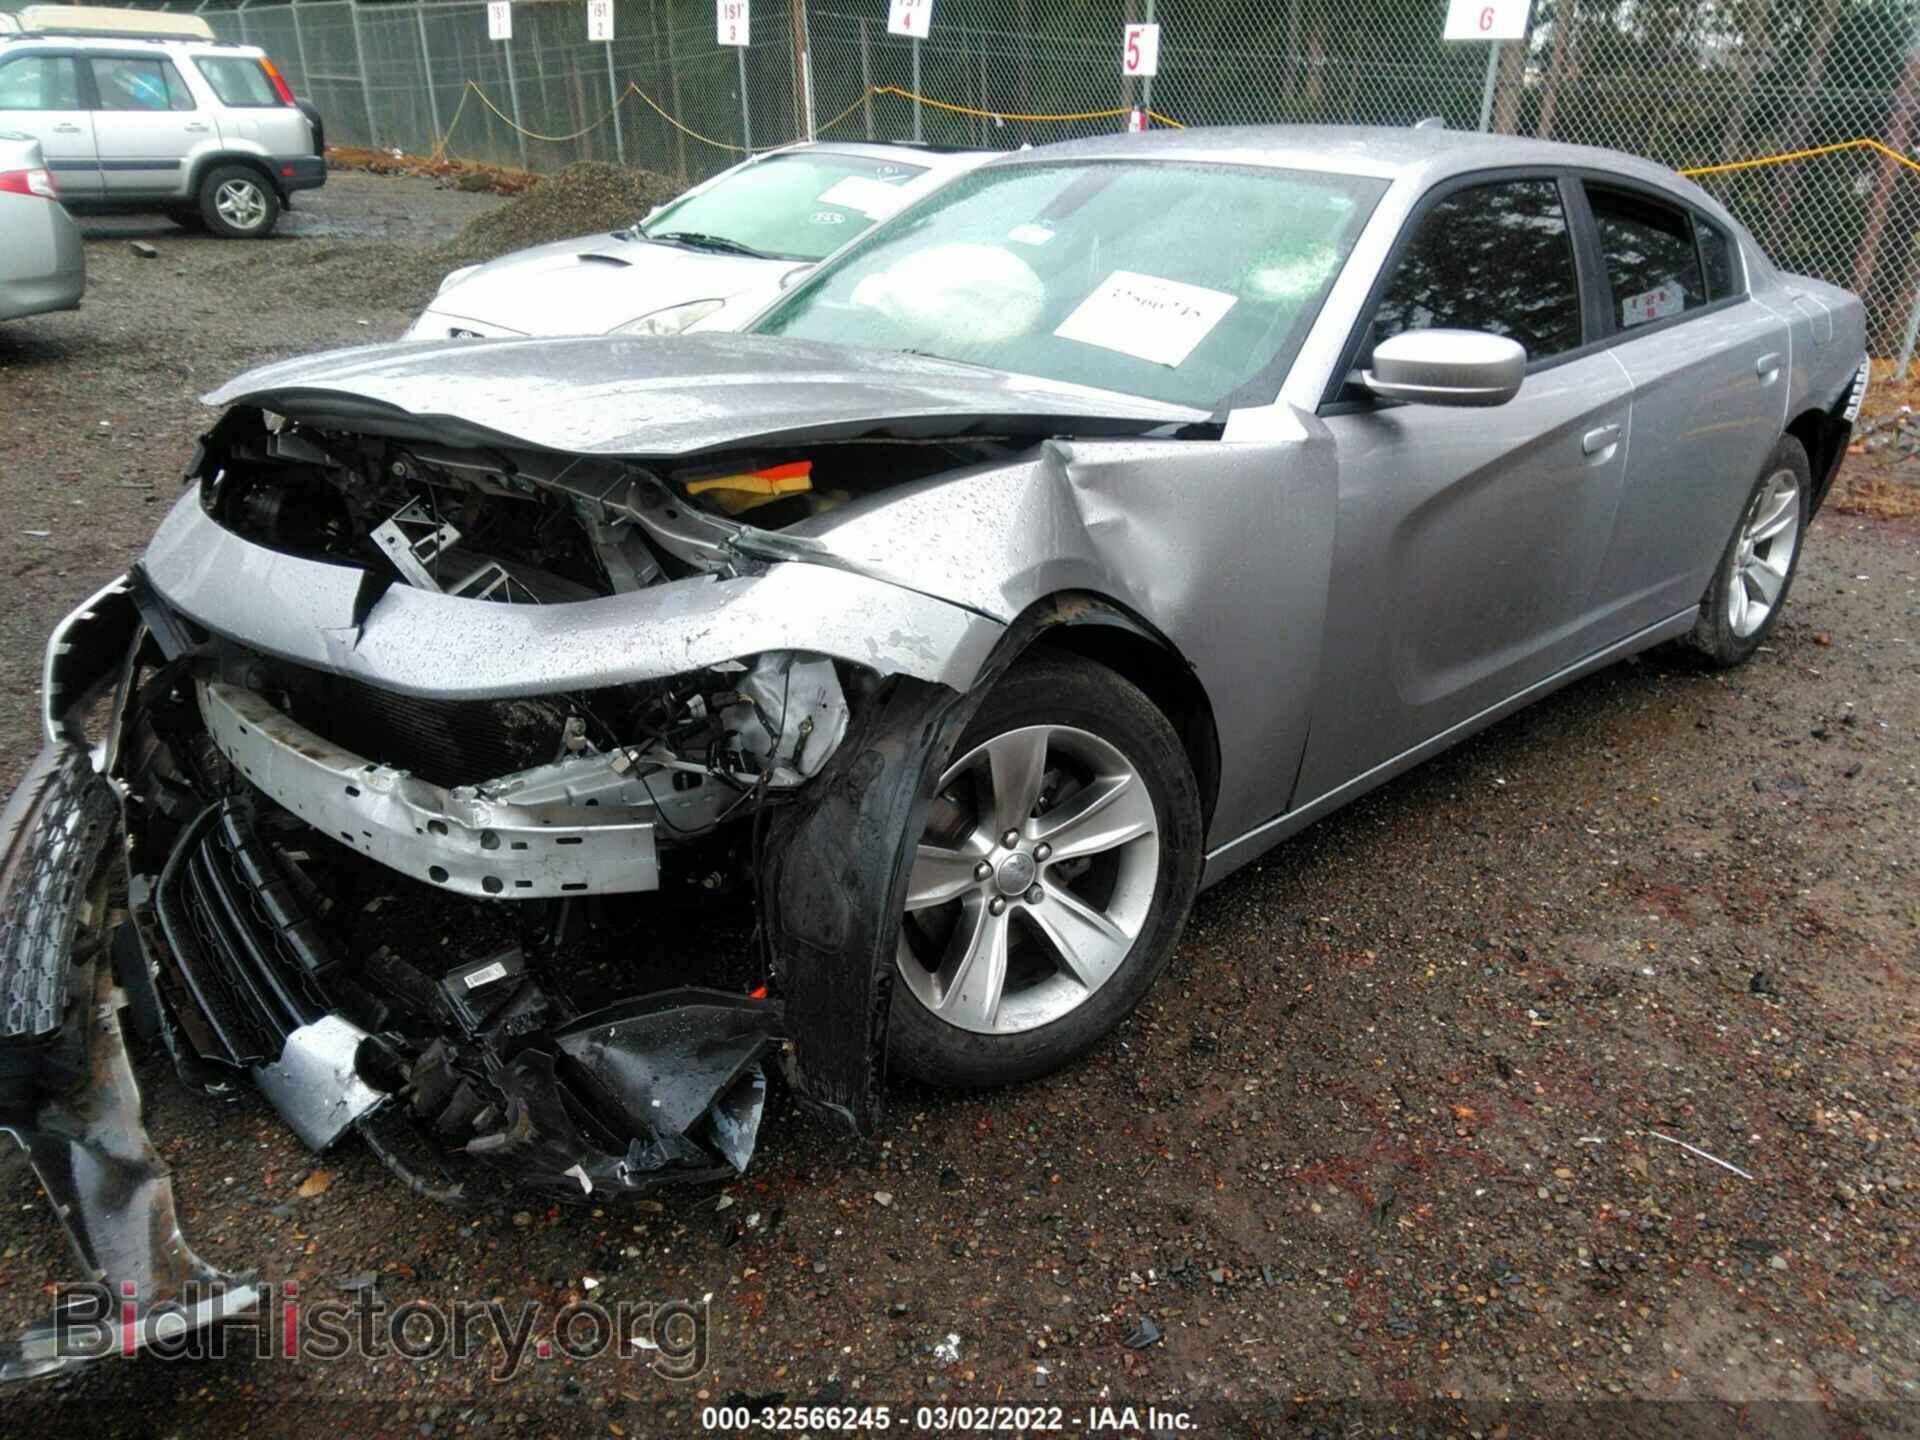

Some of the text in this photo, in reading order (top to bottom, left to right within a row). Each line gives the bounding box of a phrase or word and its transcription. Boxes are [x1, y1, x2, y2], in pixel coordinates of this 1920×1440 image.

[903, 12, 911, 30] 4
[729, 25, 737, 41] 3
[1127, 31, 1141, 70] 5
